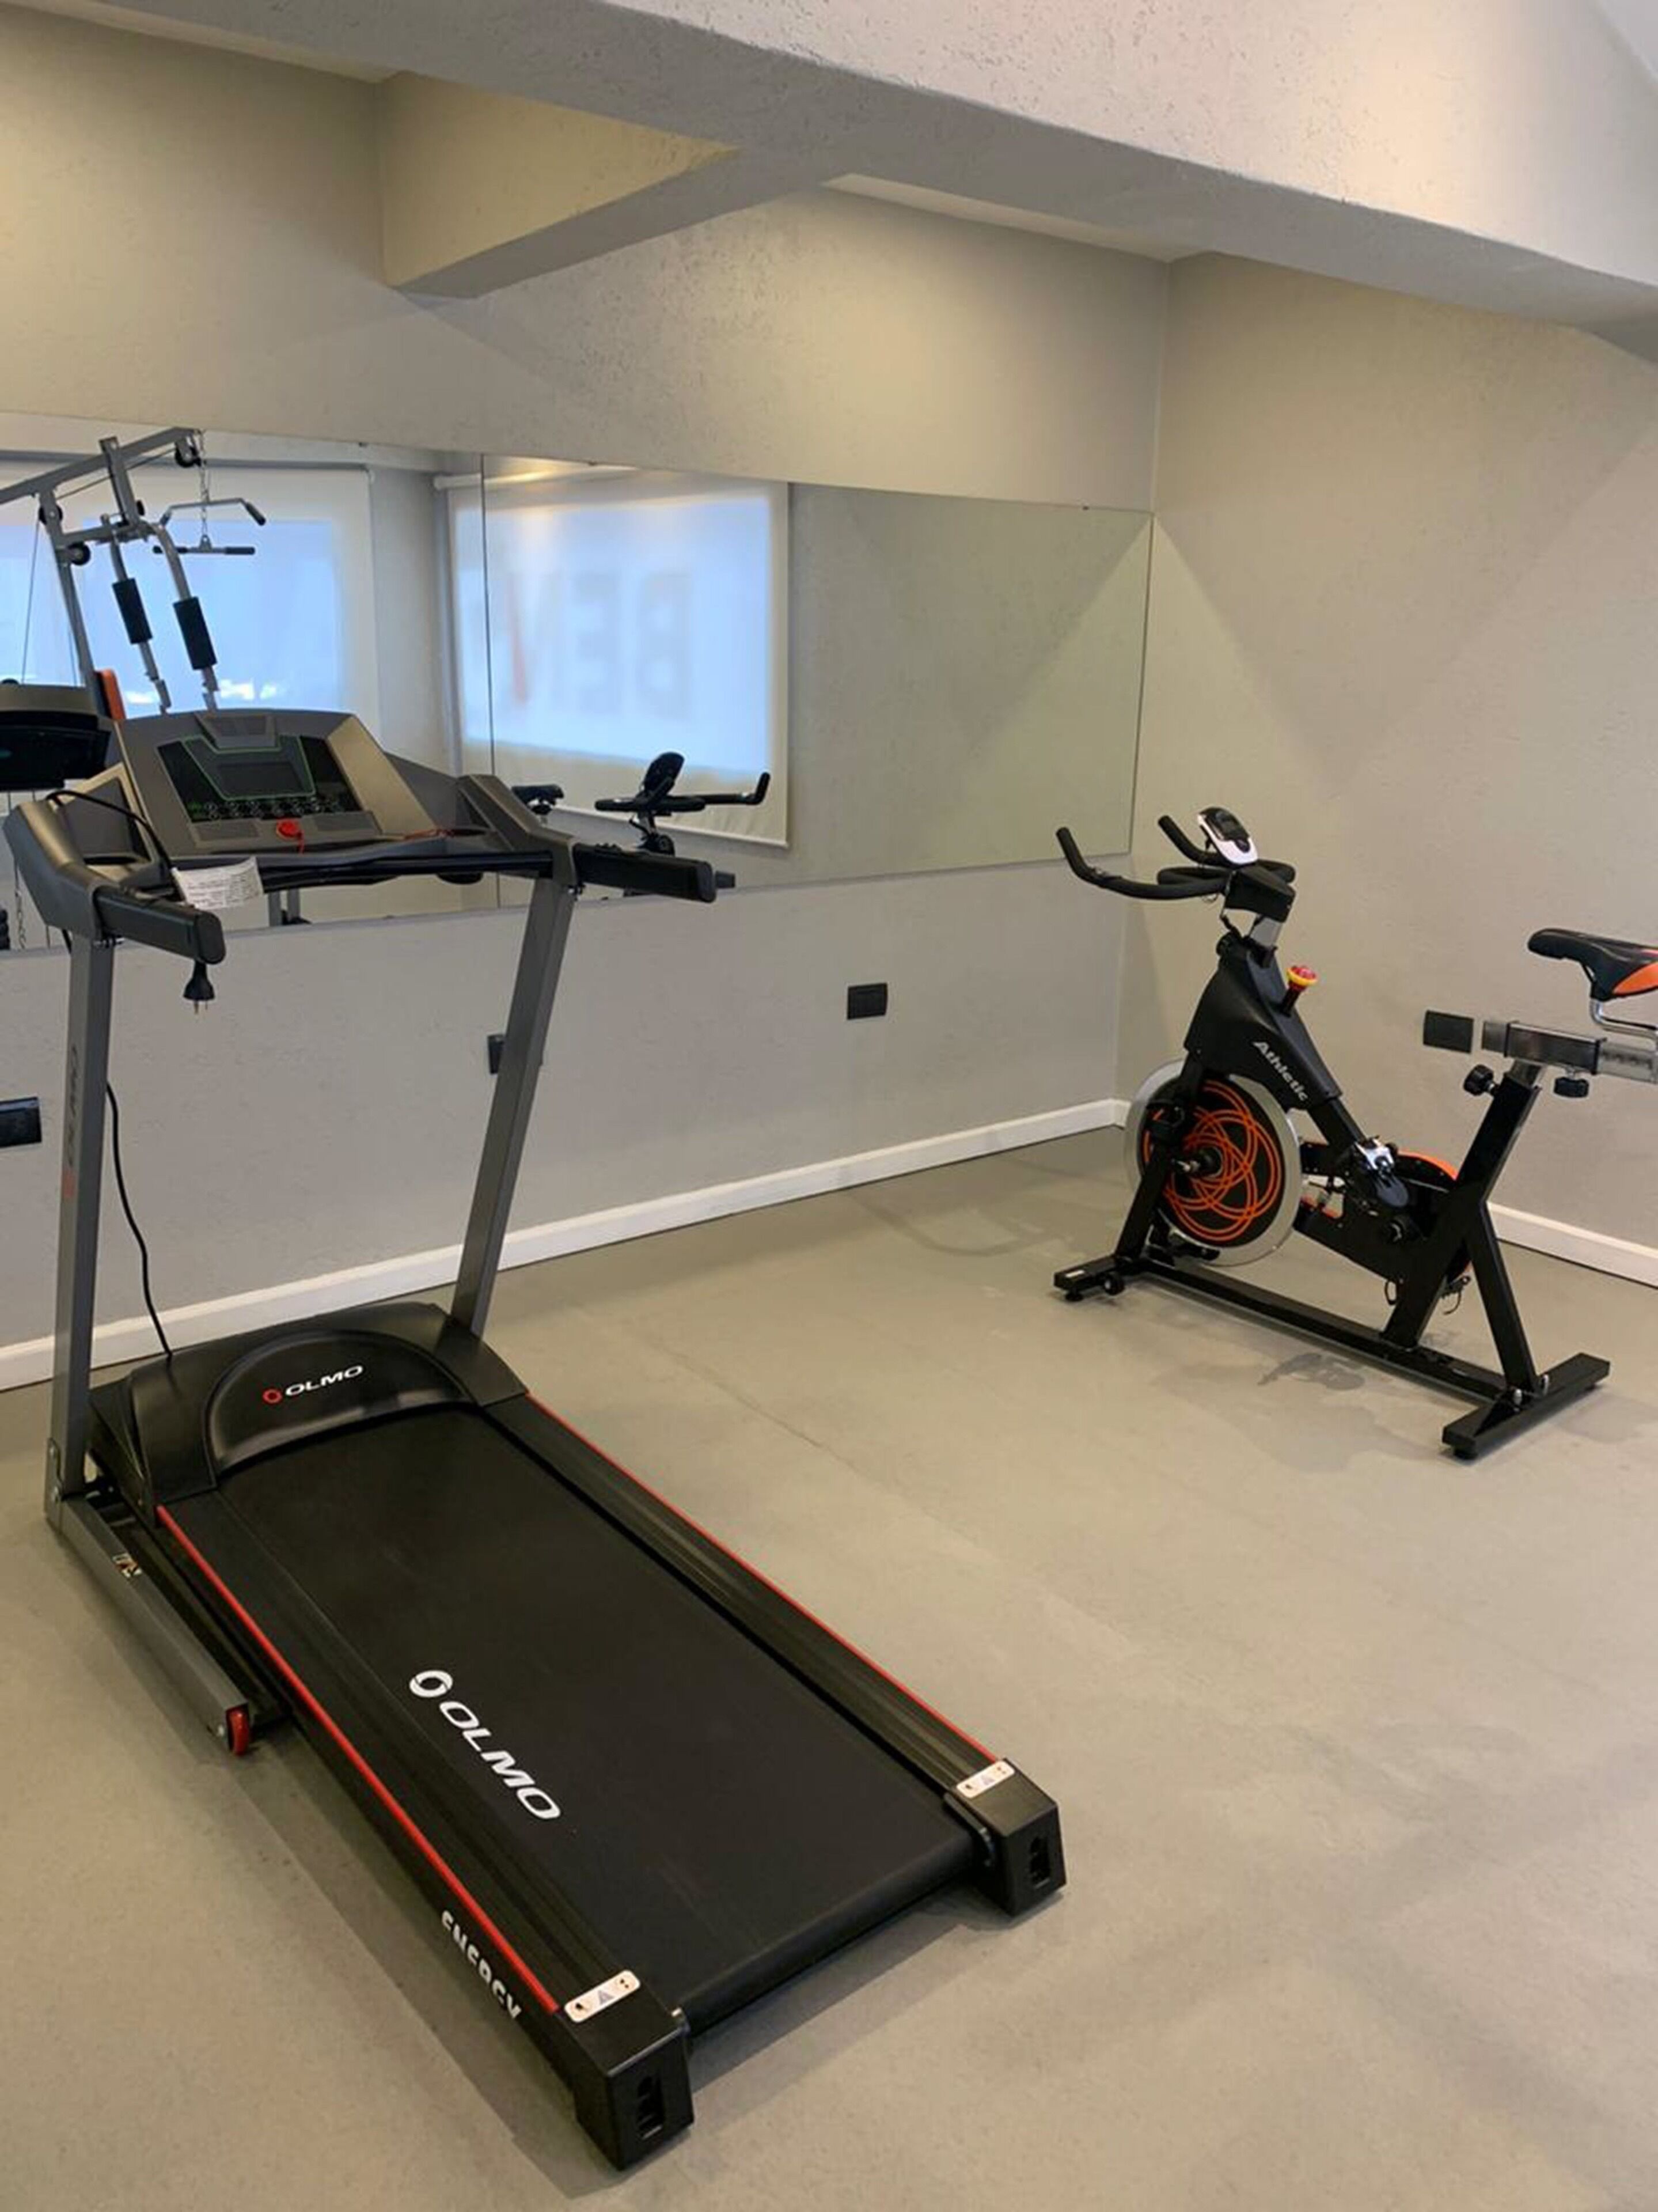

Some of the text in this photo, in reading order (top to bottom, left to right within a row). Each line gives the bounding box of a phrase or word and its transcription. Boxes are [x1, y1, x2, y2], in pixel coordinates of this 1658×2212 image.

[1253, 1041, 1308, 1101] Athletic
[285, 1365, 364, 1397] OLMO
[439, 1700, 561, 1819] OLMO
